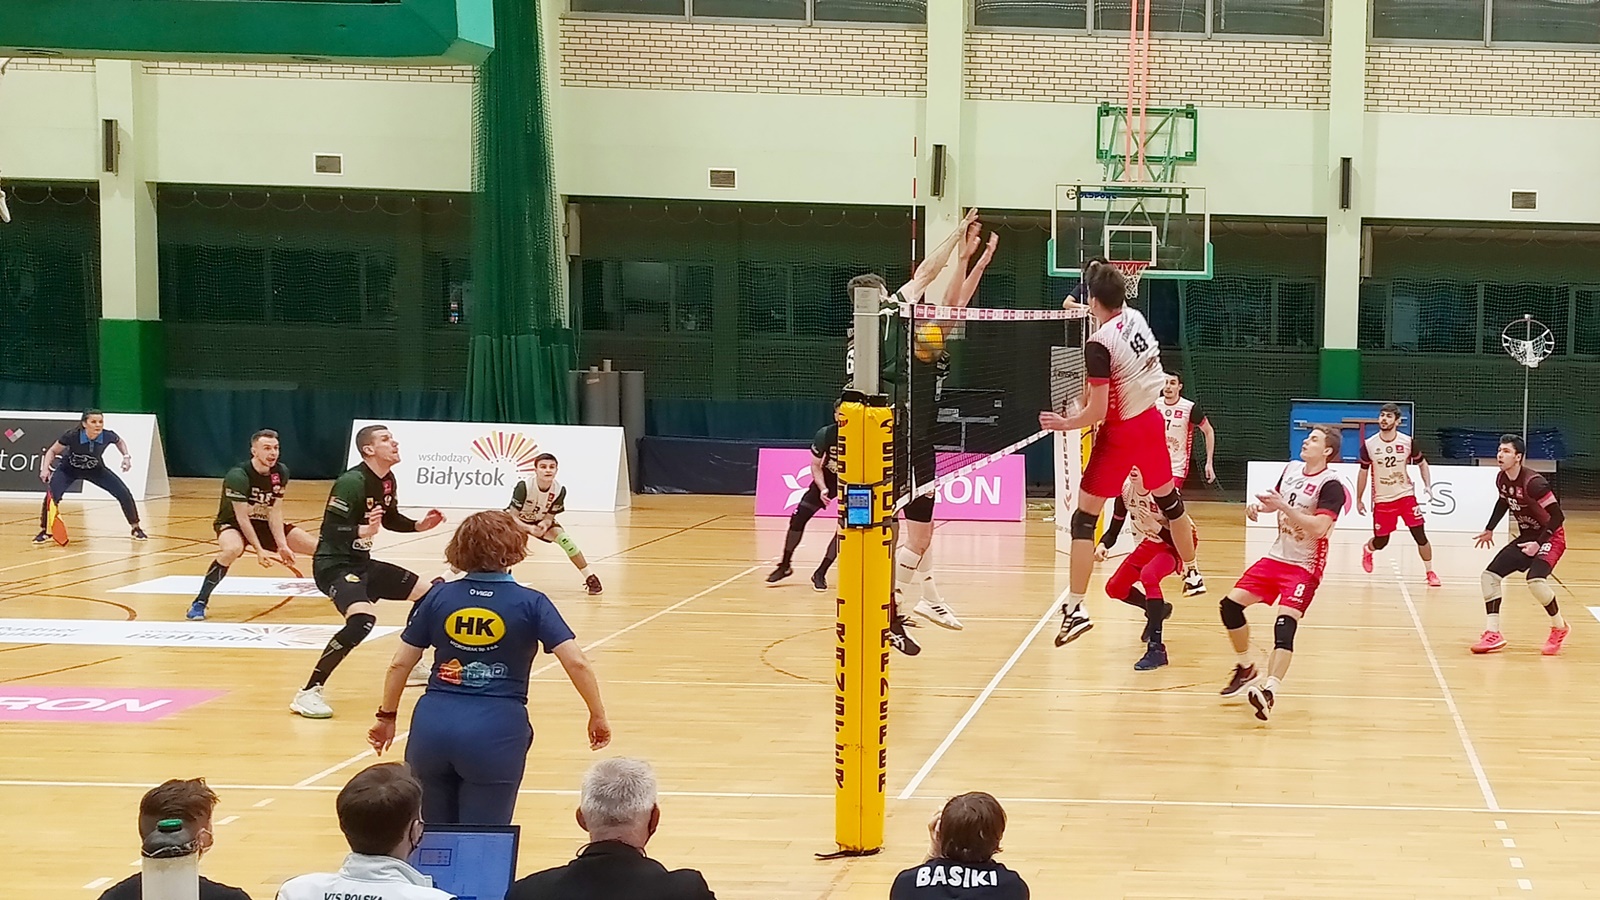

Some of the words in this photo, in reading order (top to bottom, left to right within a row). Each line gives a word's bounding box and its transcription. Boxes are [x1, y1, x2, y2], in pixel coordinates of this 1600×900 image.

[418, 452, 473, 464] wschodzący
[1384, 456, 1397, 468] 22
[416, 466, 505, 489] Białystok
[1288, 492, 1297, 507] 8
[1294, 583, 1306, 597] 8
[454, 616, 495, 637] HK
[915, 865, 998, 888] BASIKI
